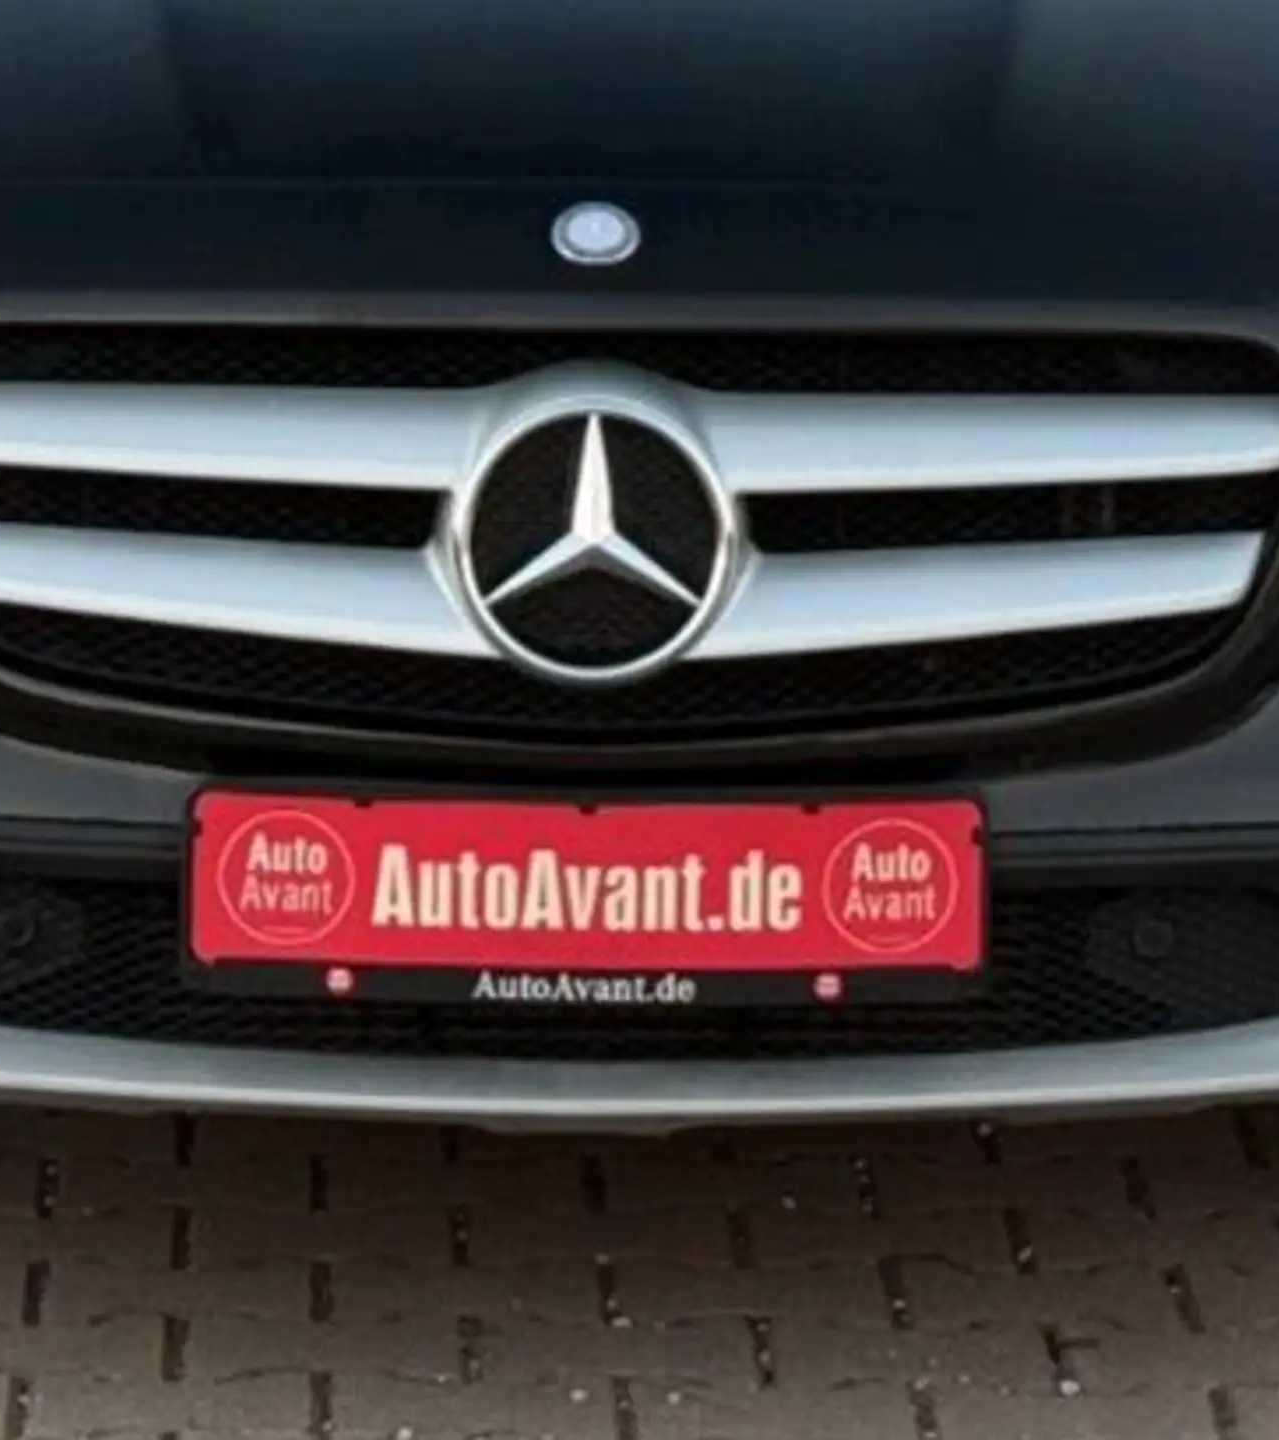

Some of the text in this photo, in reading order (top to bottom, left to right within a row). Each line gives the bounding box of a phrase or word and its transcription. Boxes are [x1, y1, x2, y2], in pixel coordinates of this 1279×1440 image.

[245, 830, 328, 875] Auto
[850, 841, 932, 882] Auto
[238, 872, 333, 916] Avant
[371, 844, 803, 932] AutoAvant.de
[842, 882, 936, 921] Avant
[471, 971, 697, 1002] AutoAvant.de
